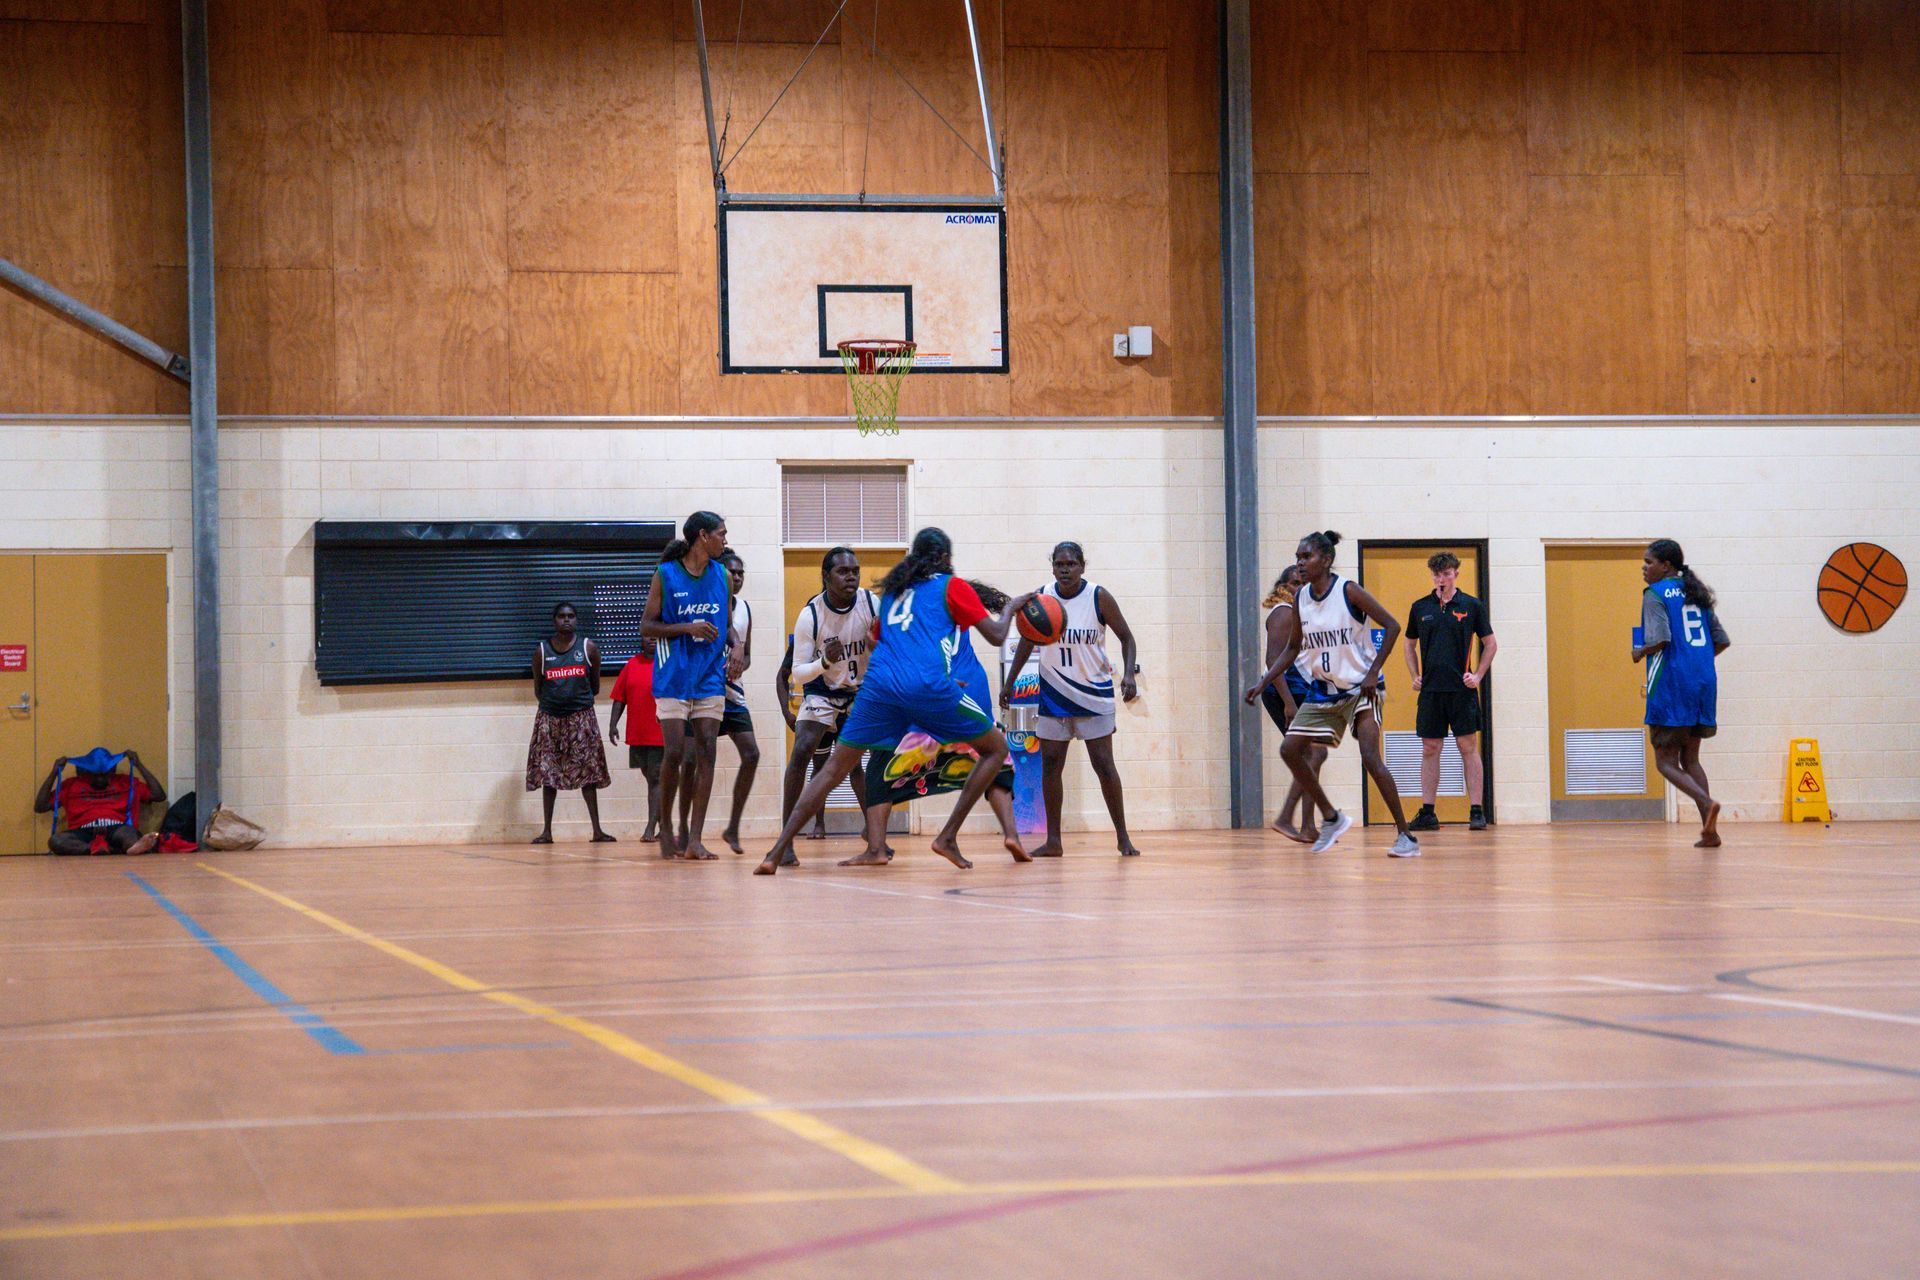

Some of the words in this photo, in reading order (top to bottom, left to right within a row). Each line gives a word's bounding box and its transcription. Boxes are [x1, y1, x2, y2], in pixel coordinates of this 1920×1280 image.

[945, 214, 997, 224] ACROMAT
[677, 603, 720, 615] LAKERS
[887, 588, 914, 632] 4
[1682, 603, 1707, 647] 6
[1059, 647, 1073, 667] 11
[1321, 651, 1330, 673] 8
[547, 667, 585, 679] Emirates
[848, 660, 858, 680] 9
